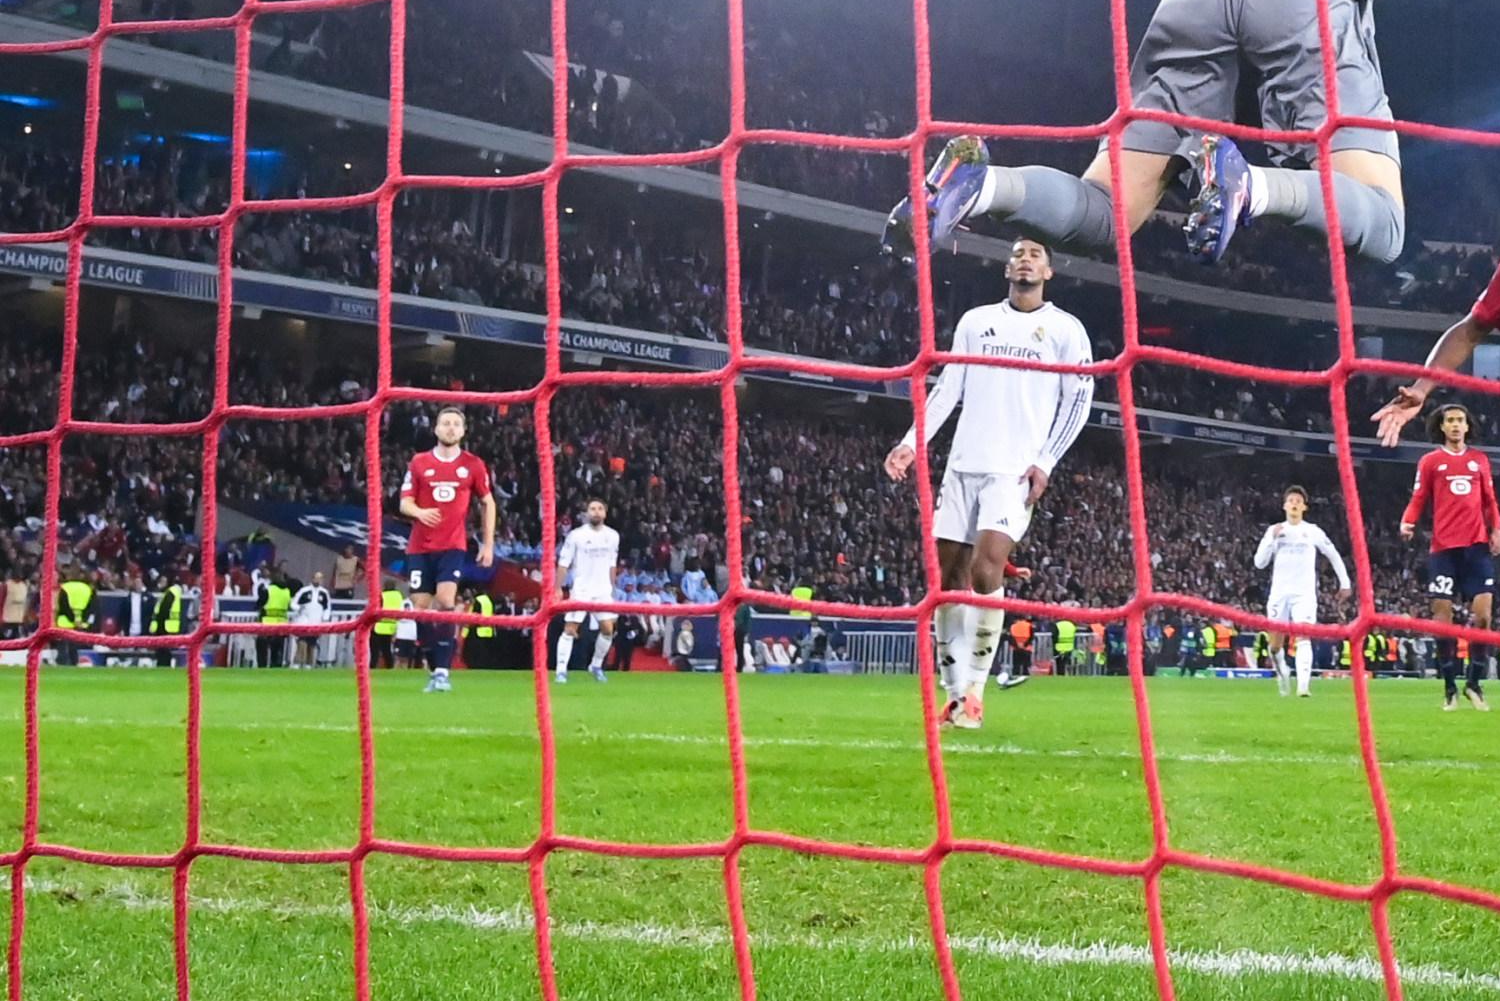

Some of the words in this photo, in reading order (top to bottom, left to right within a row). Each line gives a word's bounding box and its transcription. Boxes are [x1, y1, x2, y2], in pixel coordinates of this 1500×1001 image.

[0, 249, 84, 276] CHAMPIO
[89, 263, 144, 285] LEAGUE
[573, 334, 631, 355] CHAMPIONS
[634, 343, 673, 360] LEAGUE
[982, 343, 1042, 361] Emirates
[410, 569, 422, 589] 5
[1435, 575, 1454, 595] 32
